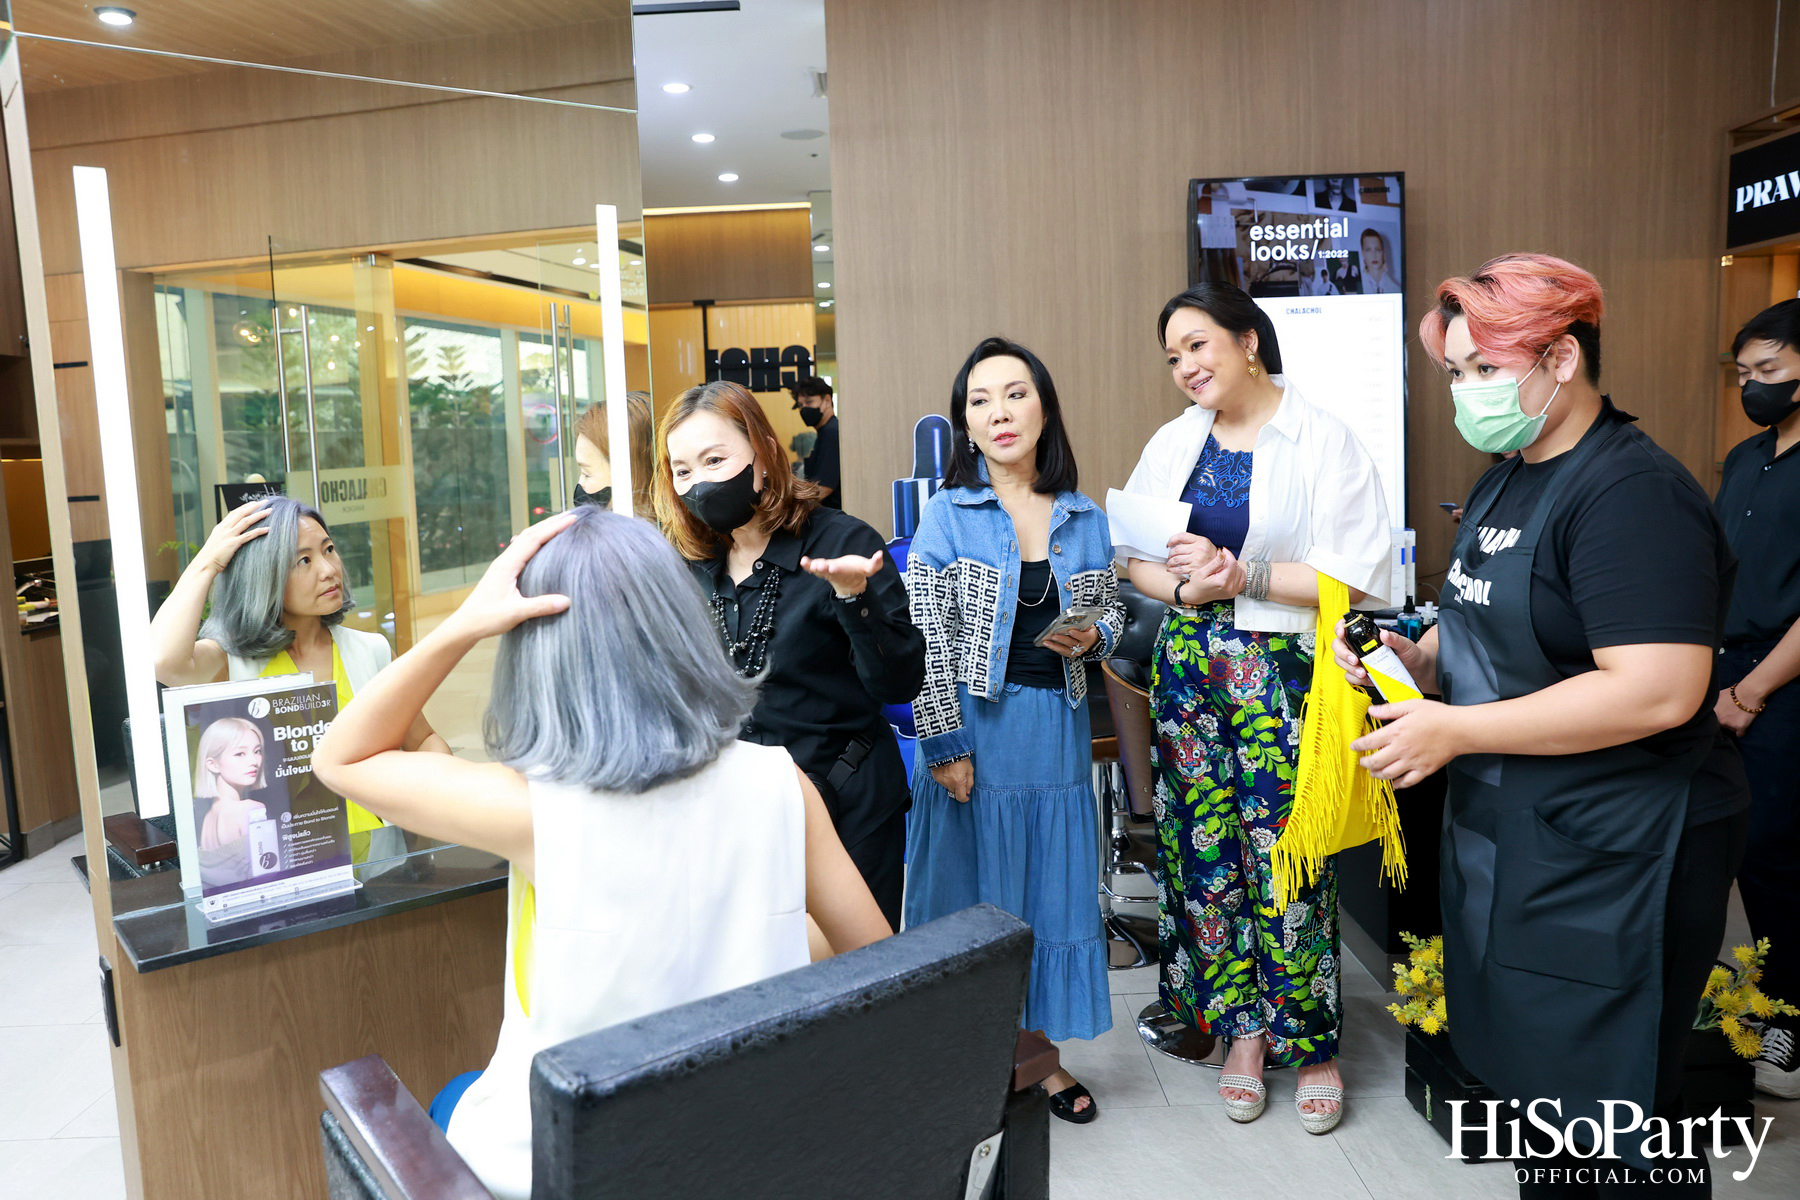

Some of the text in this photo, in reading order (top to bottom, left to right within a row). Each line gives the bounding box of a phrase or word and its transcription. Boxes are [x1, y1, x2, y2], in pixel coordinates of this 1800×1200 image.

[1249, 217, 1349, 241] essential
[1285, 307, 1322, 315] CHALACHOL
[272, 693, 321, 708] BRAZILIAN
[275, 700, 332, 715] BONDBUILD3R
[290, 739, 309, 752] to
